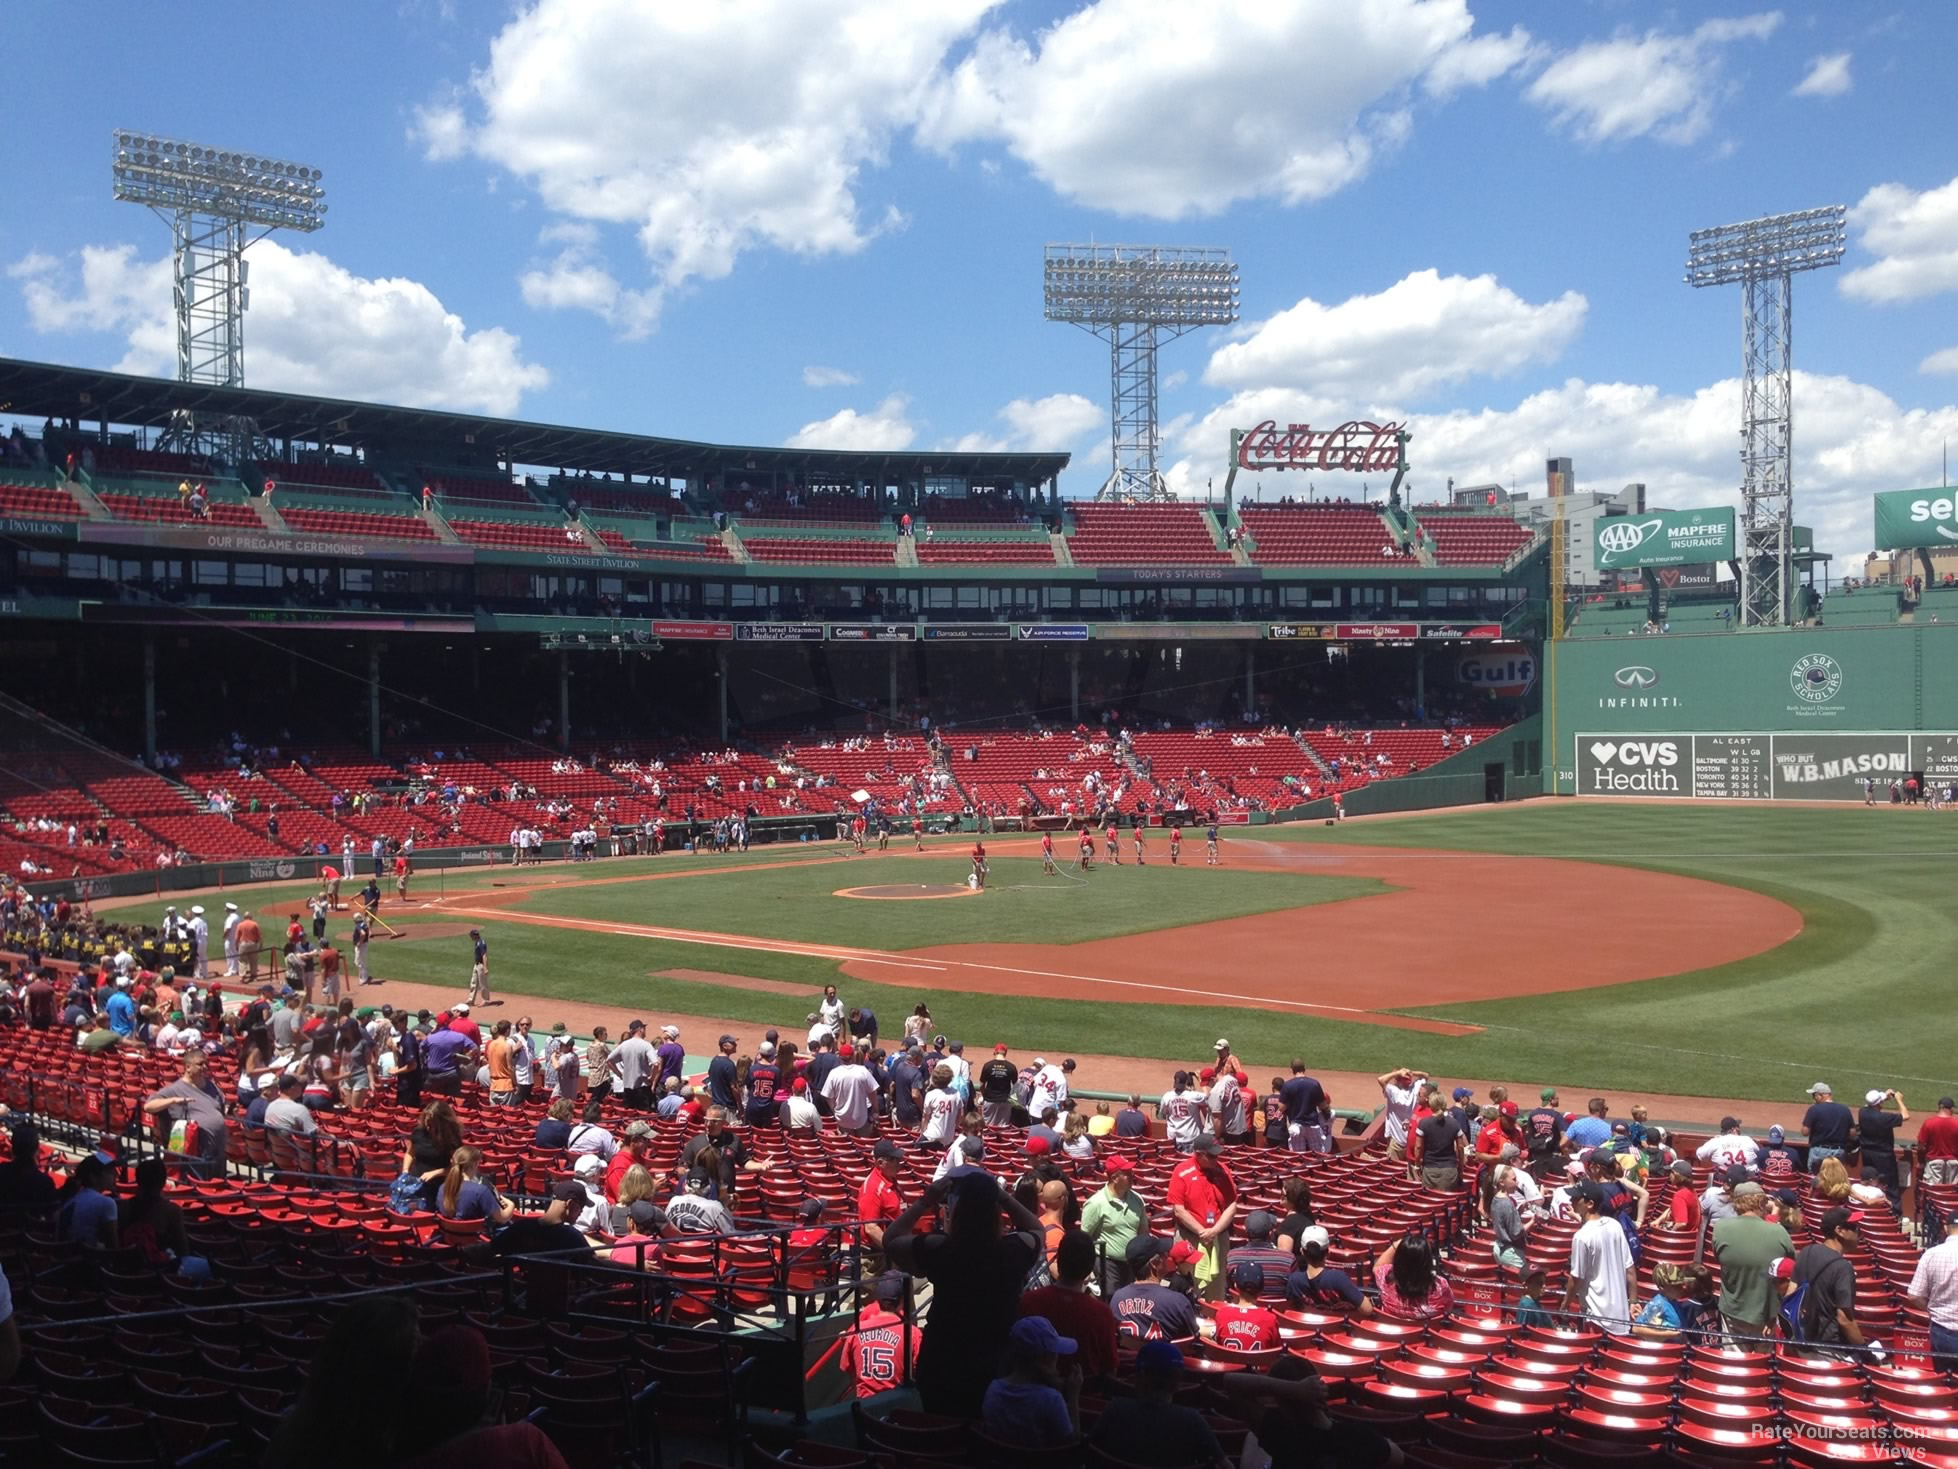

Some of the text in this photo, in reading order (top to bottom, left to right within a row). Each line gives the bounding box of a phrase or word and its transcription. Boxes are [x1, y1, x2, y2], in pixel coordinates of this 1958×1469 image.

[1667, 523, 1727, 539] MAPFRE
[207, 535, 365, 556] OUR PREGAME CEREMONIES
[1671, 537, 1723, 549] INSURANCE
[546, 553, 640, 569] STATE STREET PAVILION
[1638, 555, 1684, 564] Auto Insurance
[1132, 570, 1222, 579] TODAY'S STARTERS
[752, 632, 801, 640] Medical Center
[1271, 625, 1296, 637] Tribe
[1351, 627, 1372, 635] Ninety
[1426, 629, 1463, 637] Safelite
[1793, 658, 1810, 677] RED
[1812, 655, 1833, 669] SOX
[1461, 659, 1531, 682] Gulf
[1794, 672, 1839, 700] SCHOLARS
[1618, 742, 1678, 766] CVS
[1695, 757, 1728, 765] BALTIMORE
[1775, 754, 1814, 763] WHO BUT
[1559, 771, 1573, 780] 310
[1730, 765, 1739, 773] 39
[1740, 765, 1749, 773] 32
[1593, 767, 1679, 791] Health
[1854, 777, 1903, 785] SICE 188
[752, 1079, 774, 1098] 15
[1038, 1073, 1056, 1093] 34
[939, 1100, 952, 1114] 24
[1172, 1104, 1188, 1118] 15
[1722, 1150, 1748, 1167] 34
[1765, 1158, 1793, 1176] 26
[669, 1203, 706, 1220] PEDROIA
[1474, 1292, 1491, 1300] BOX
[1118, 1297, 1155, 1316] ORTIZ
[1227, 1320, 1260, 1338] PRICE
[858, 1328, 900, 1349] PEDROIA
[1904, 1340, 1923, 1348] BOX
[861, 1346, 895, 1380] 15
